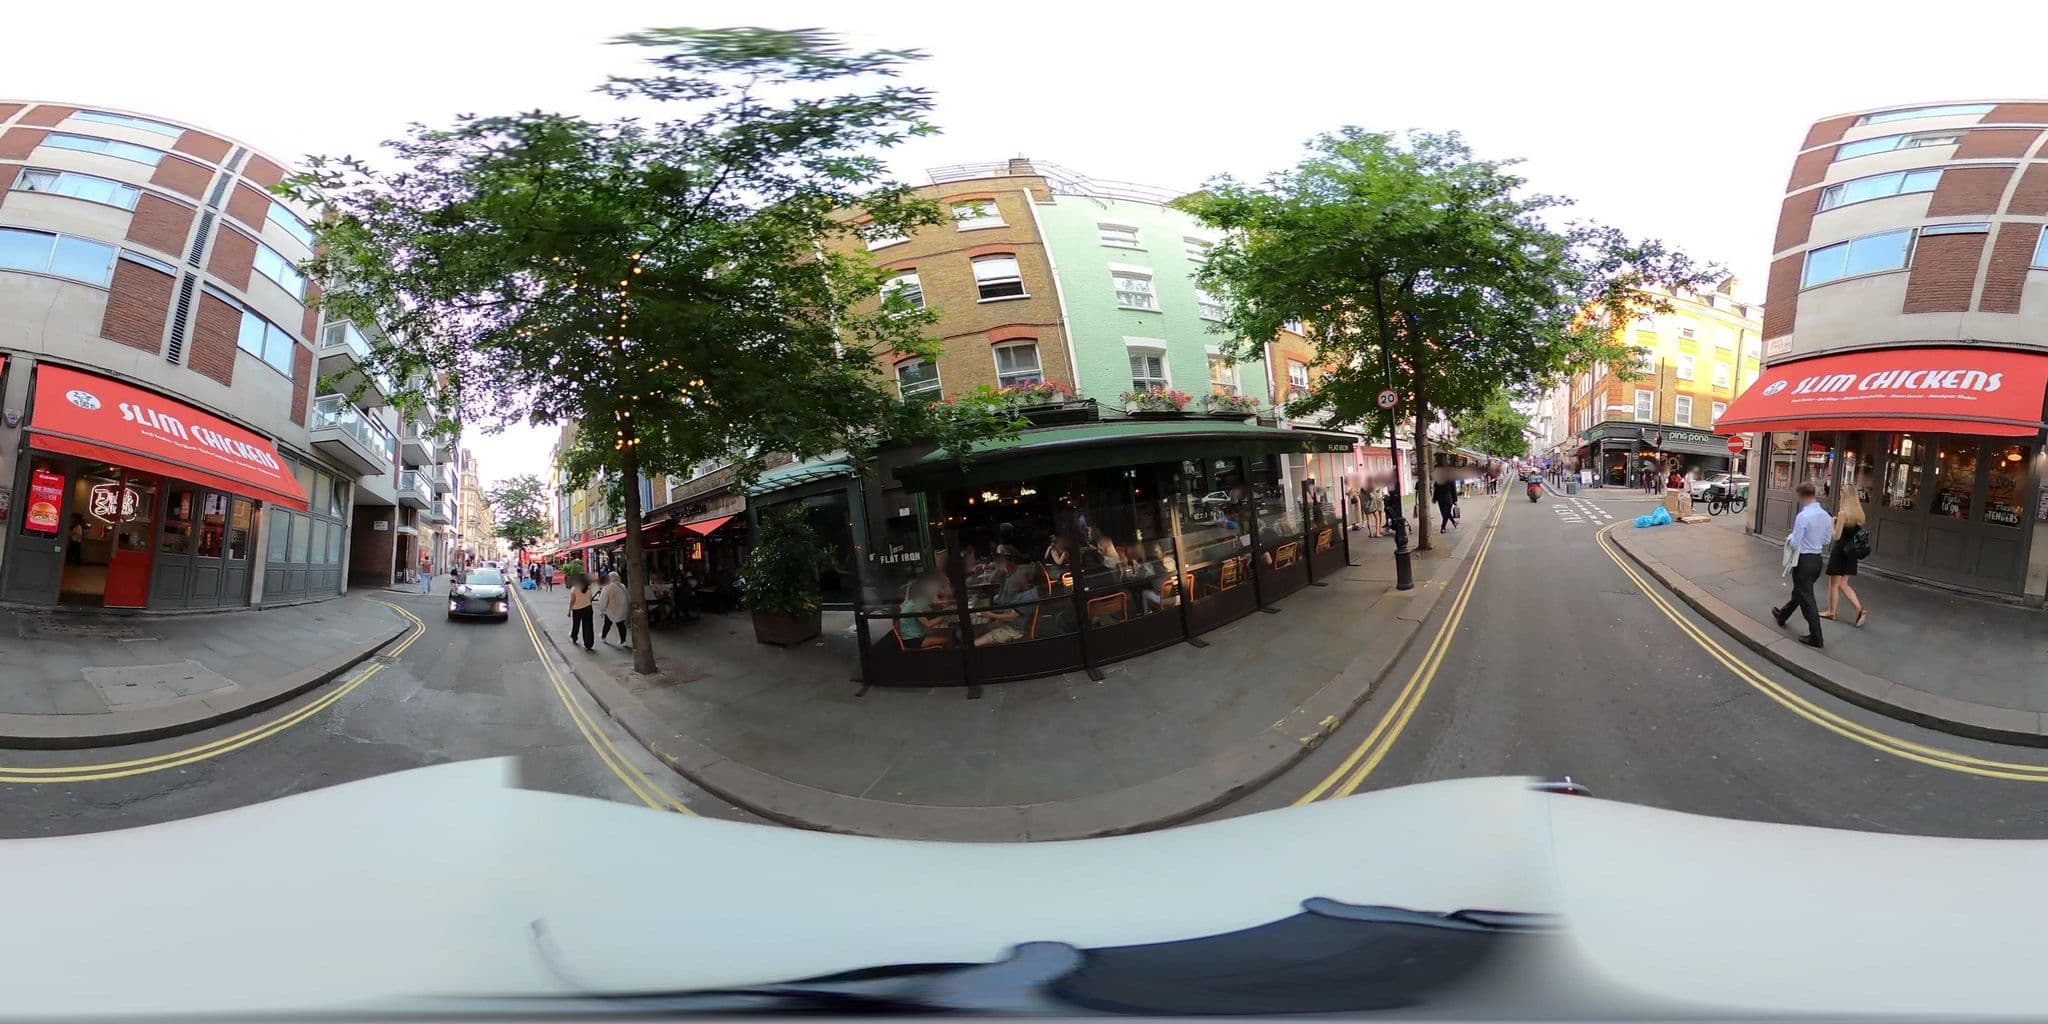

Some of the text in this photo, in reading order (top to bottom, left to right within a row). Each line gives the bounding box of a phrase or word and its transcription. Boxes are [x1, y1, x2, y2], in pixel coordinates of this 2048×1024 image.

[1791, 374, 1857, 395] SLIM
[1858, 369, 2003, 392] CHICKENS
[1381, 394, 1395, 404] 20
[119, 402, 280, 471] SLIM CHICKENS
[880, 554, 899, 564] FLAT
[901, 552, 920, 562] IRON
